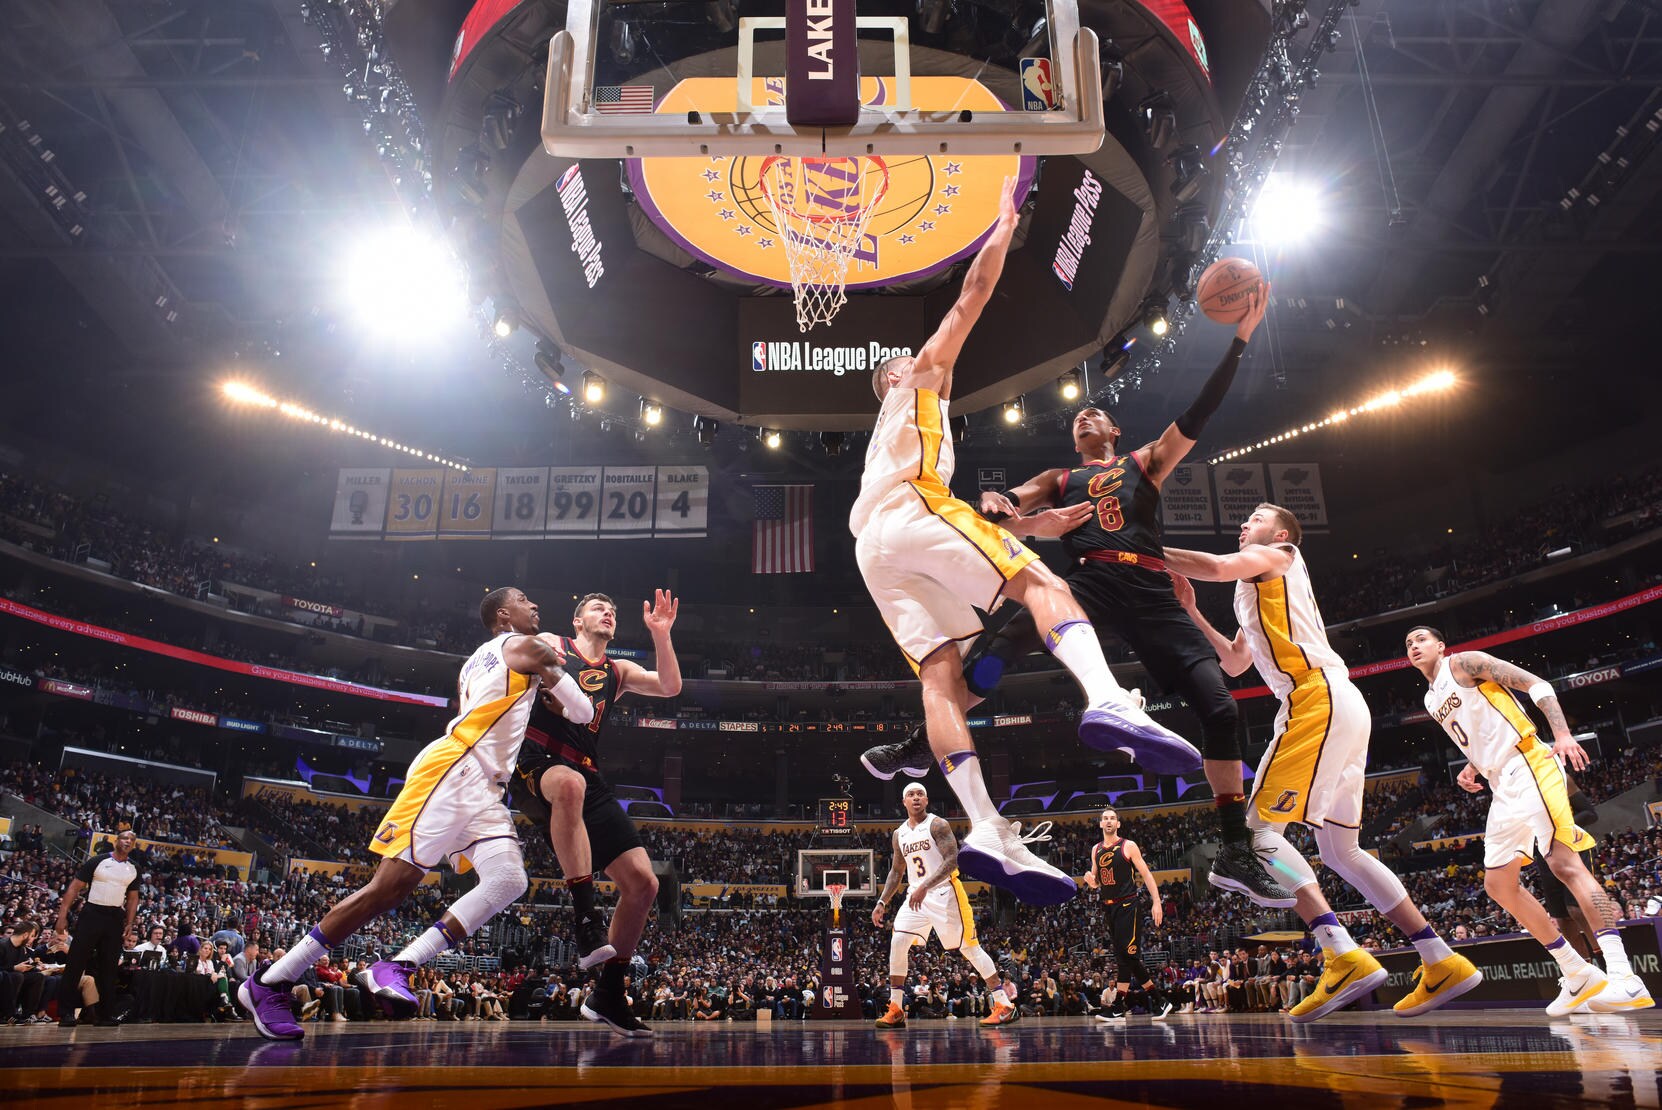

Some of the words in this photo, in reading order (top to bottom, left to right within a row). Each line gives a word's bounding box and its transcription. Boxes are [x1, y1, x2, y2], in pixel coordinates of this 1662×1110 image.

[1028, 101, 1043, 110] NBA
[560, 171, 587, 219] NBA
[1074, 169, 1102, 217] Pass
[568, 198, 596, 261] League
[1061, 203, 1092, 260] League
[582, 241, 605, 289] Pass
[1055, 240, 1079, 282] NBA
[768, 342, 801, 370] NBA
[804, 342, 866, 376] League
[345, 476, 381, 485] MILLER
[400, 476, 436, 485] VACHON
[554, 474, 597, 484] GRETZKY
[605, 474, 653, 484] ROBITAILLE
[668, 474, 699, 483] BLAKE
[981, 471, 1003, 481] LA
[394, 493, 433, 521] 30
[451, 492, 481, 520] 16
[504, 492, 535, 521] 18
[554, 491, 594, 520] 99
[607, 491, 648, 519] 20
[671, 490, 690, 518] 4
[1096, 496, 1125, 532] 8
[1118, 551, 1138, 564] CAVS
[292, 598, 333, 615] TOYOTA
[1533, 622, 1554, 633] Give
[1556, 616, 1576, 628] your
[1577, 604, 1617, 621] business
[1617, 596, 1641, 609] every
[9, 602, 48, 622] business
[49, 616, 75, 632] every
[251, 666, 272, 677] Give
[272, 670, 291, 682] your
[291, 672, 326, 687] business
[1567, 668, 1620, 688] TOYOTA
[172, 707, 217, 725] TOSHIBA
[226, 720, 241, 728] BUD
[240, 722, 260, 732] LIGHT
[994, 716, 1032, 726] TOSHIBA
[720, 722, 757, 732] STAPLES
[1451, 721, 1469, 747] 0
[348, 738, 380, 751] DELTA
[828, 801, 849, 811] 2:49
[831, 811, 846, 827] 13
[902, 839, 931, 857] LAKERS
[912, 856, 926, 878] 3
[1100, 867, 1116, 886] 81
